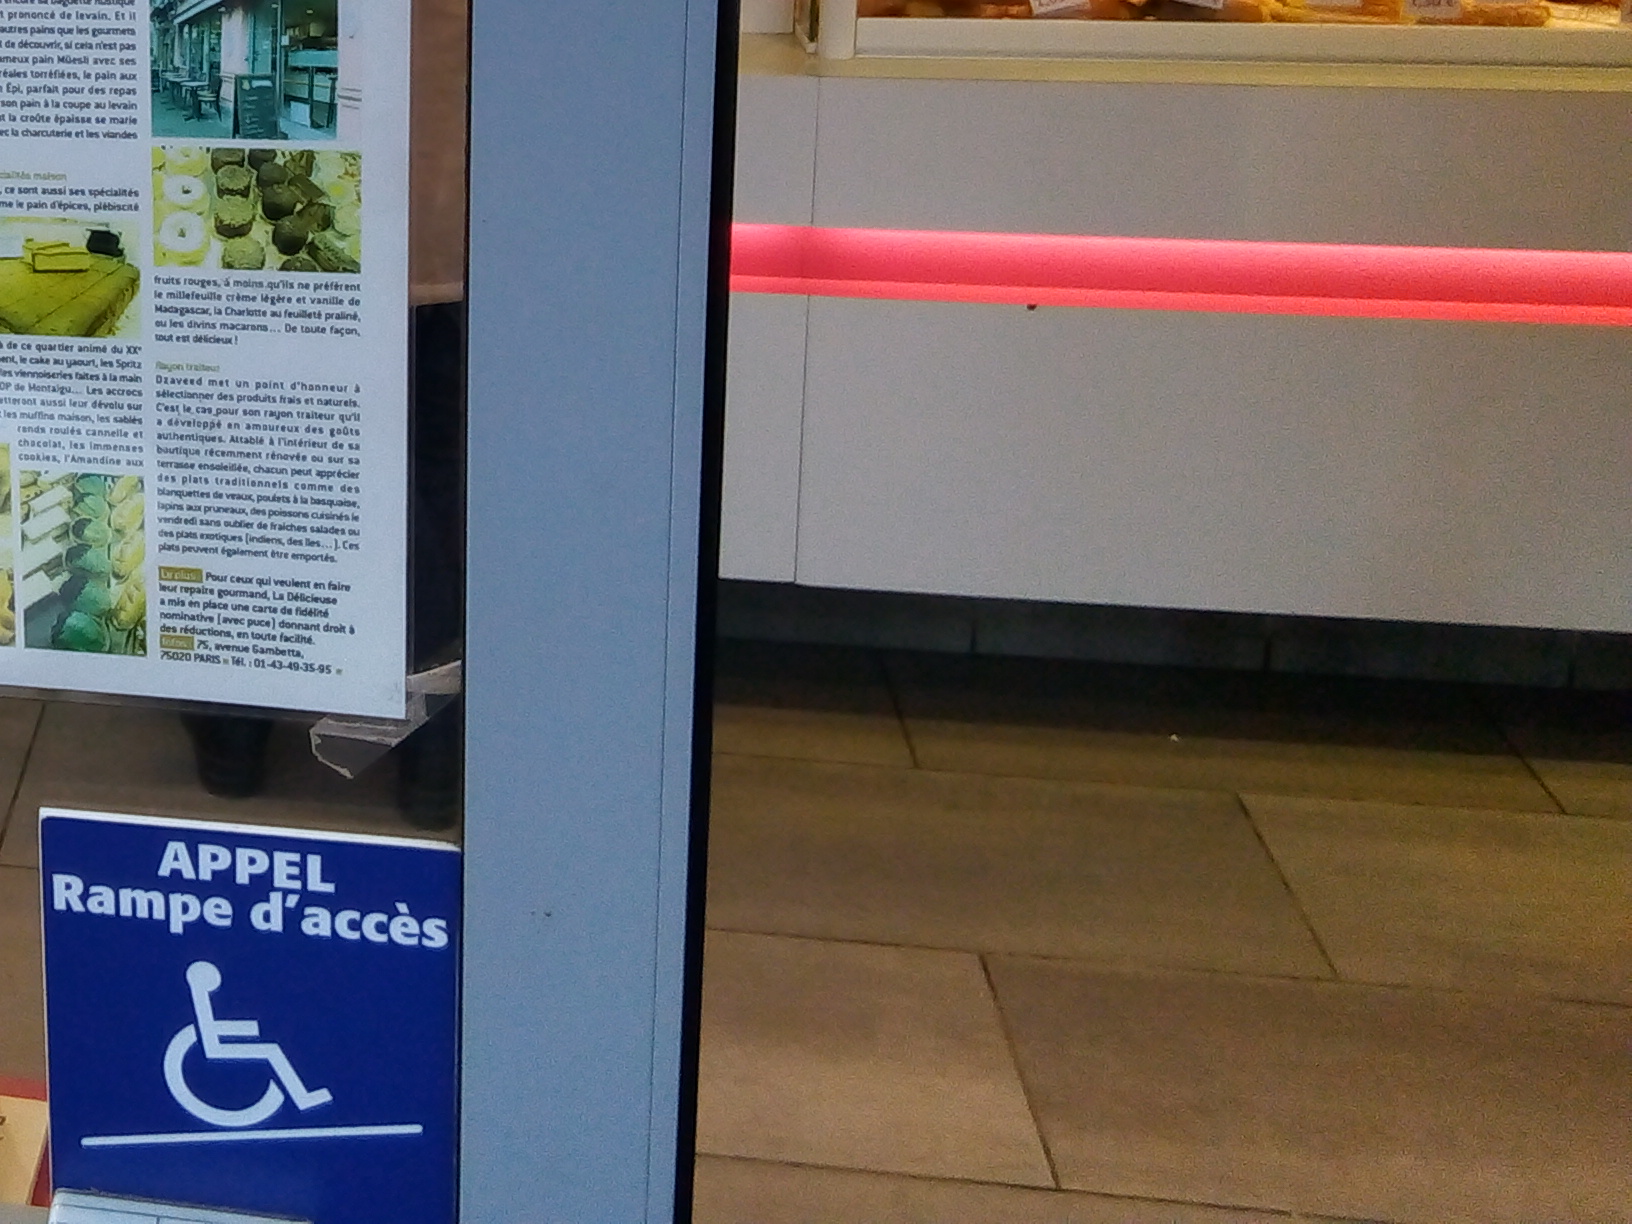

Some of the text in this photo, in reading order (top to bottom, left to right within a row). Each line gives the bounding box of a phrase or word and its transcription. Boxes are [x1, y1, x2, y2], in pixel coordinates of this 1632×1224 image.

[7, 9, 55, 22] prononcé
[59, 9, 71, 20] de
[75, 9, 110, 21] levain.
[114, 10, 125, 21] Et
[128, 10, 136, 21] il
[30, 68, 81, 80] torréfiées,
[82, 69, 91, 80] le
[94, 69, 116, 83] pain
[119, 72, 136, 81] aux
[26, 83, 58, 97] parfait
[61, 86, 84, 97] pour
[88, 84, 105, 95] des
[108, 86, 136, 98] repas
[4, 186, 14, 195] ce
[17, 184, 38, 195] sont
[41, 184, 66, 196] aussi
[68, 187, 85, 196] ses
[88, 185, 138, 200] spécialités
[155, 374, 360, 393] Dzaveed met un point d'honneur à
[155, 388, 359, 408] sélectionner des produits frais et naturels.
[197, 639, 303, 658] 75, avenue Gambetta,
[160, 652, 191, 663] 75020
[194, 653, 221, 664] PARIS
[158, 840, 336, 894] APPEL
[51, 873, 449, 949] Rampe d'accès
